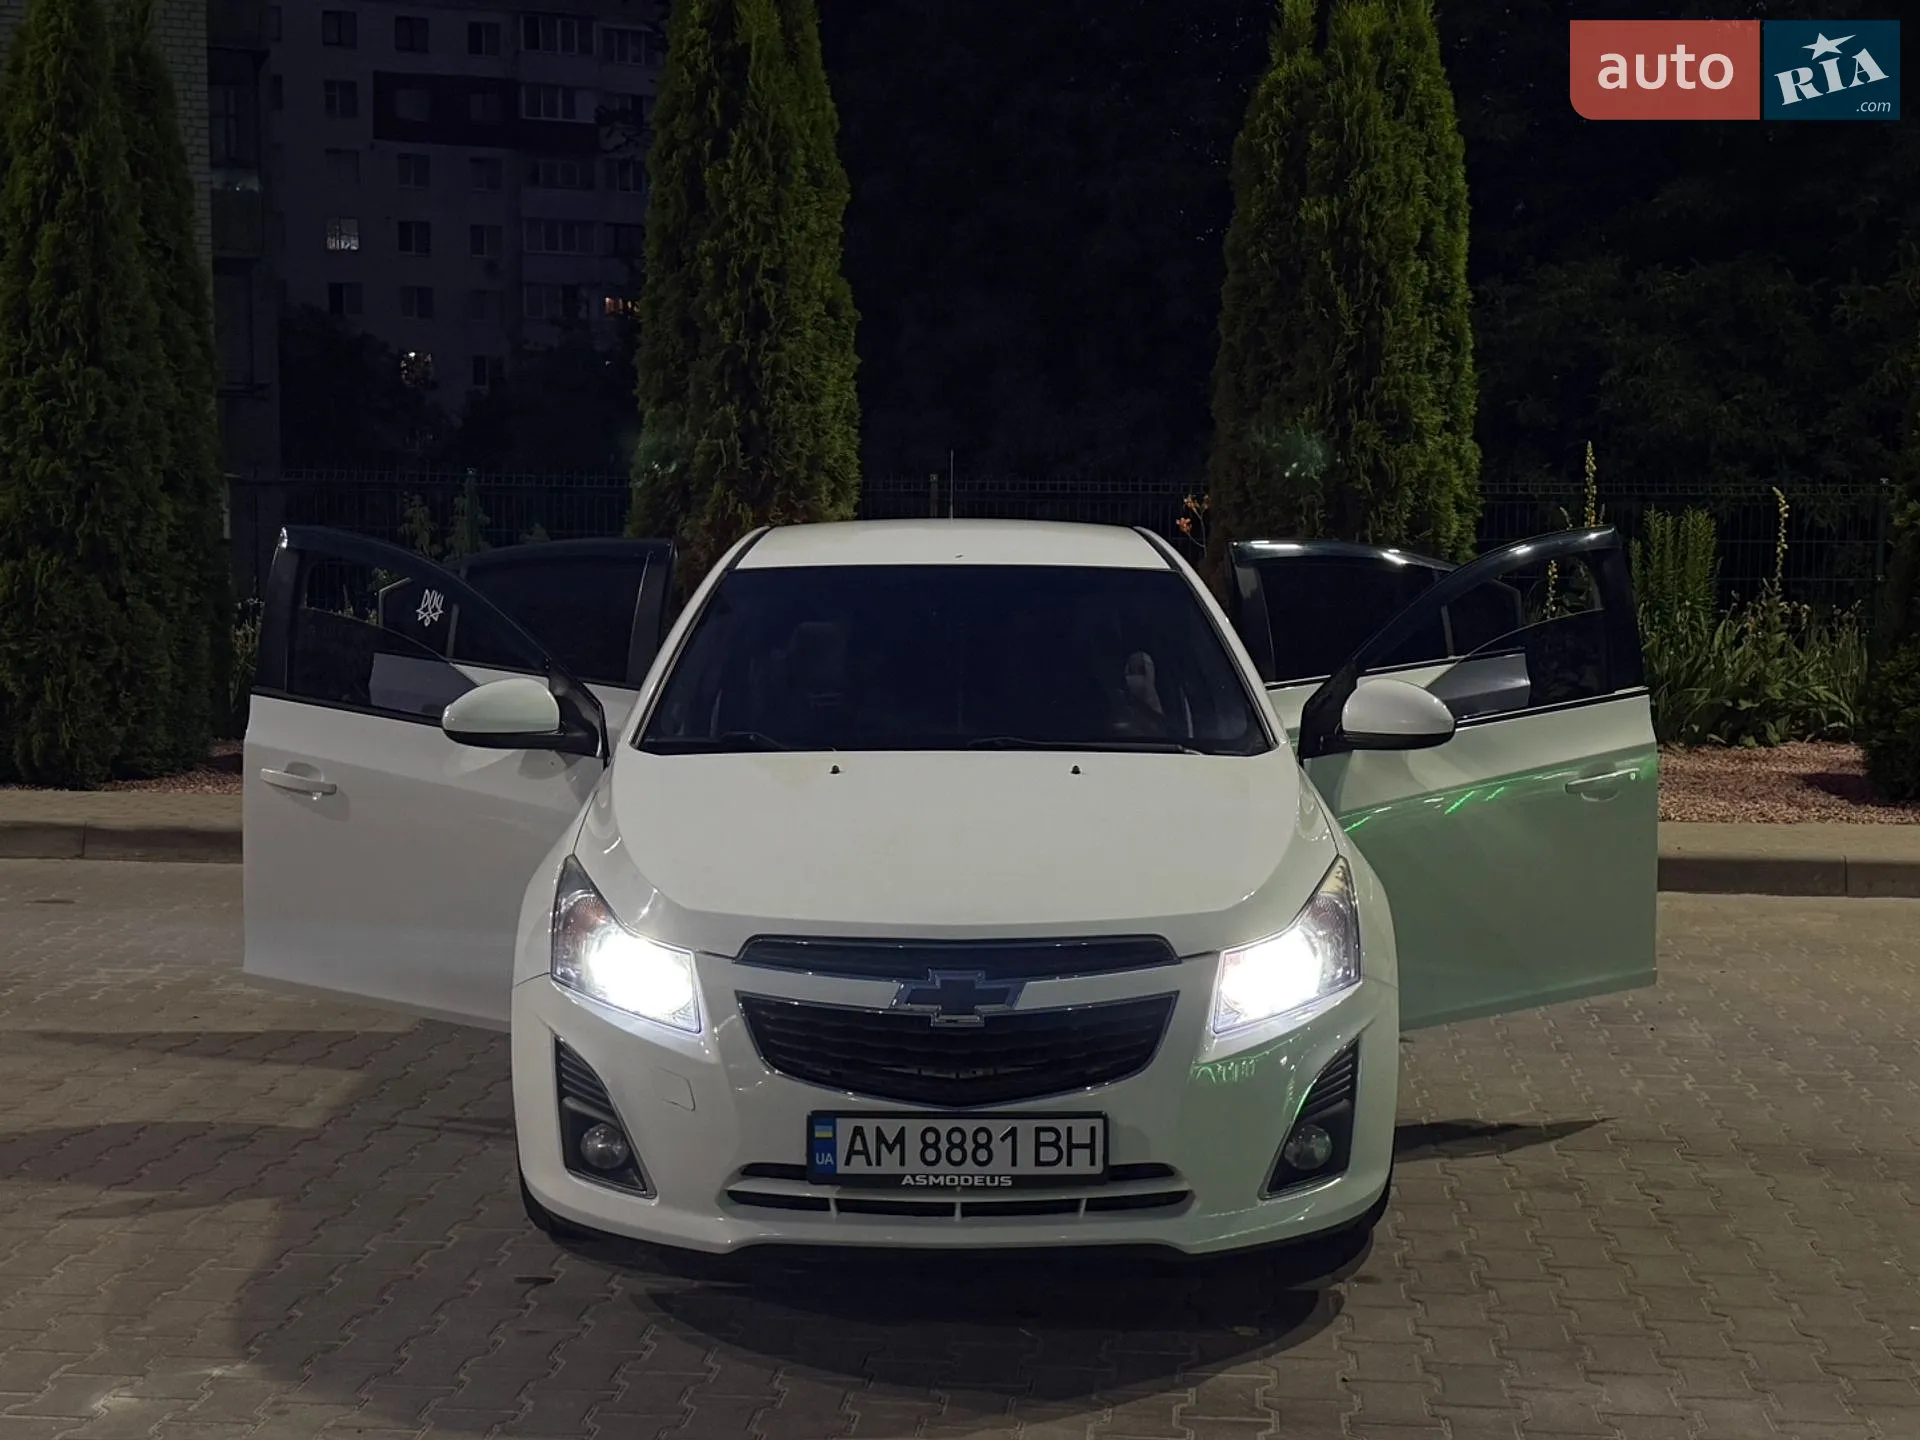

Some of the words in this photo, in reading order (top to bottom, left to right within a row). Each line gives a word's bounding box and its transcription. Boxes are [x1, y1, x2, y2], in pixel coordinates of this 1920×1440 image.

[844, 1126, 906, 1167] AM
[920, 1126, 1017, 1167] 8881
[1034, 1126, 1096, 1167] BH
[815, 1152, 836, 1166] UA
[900, 1174, 1013, 1187] ASMODEUS
